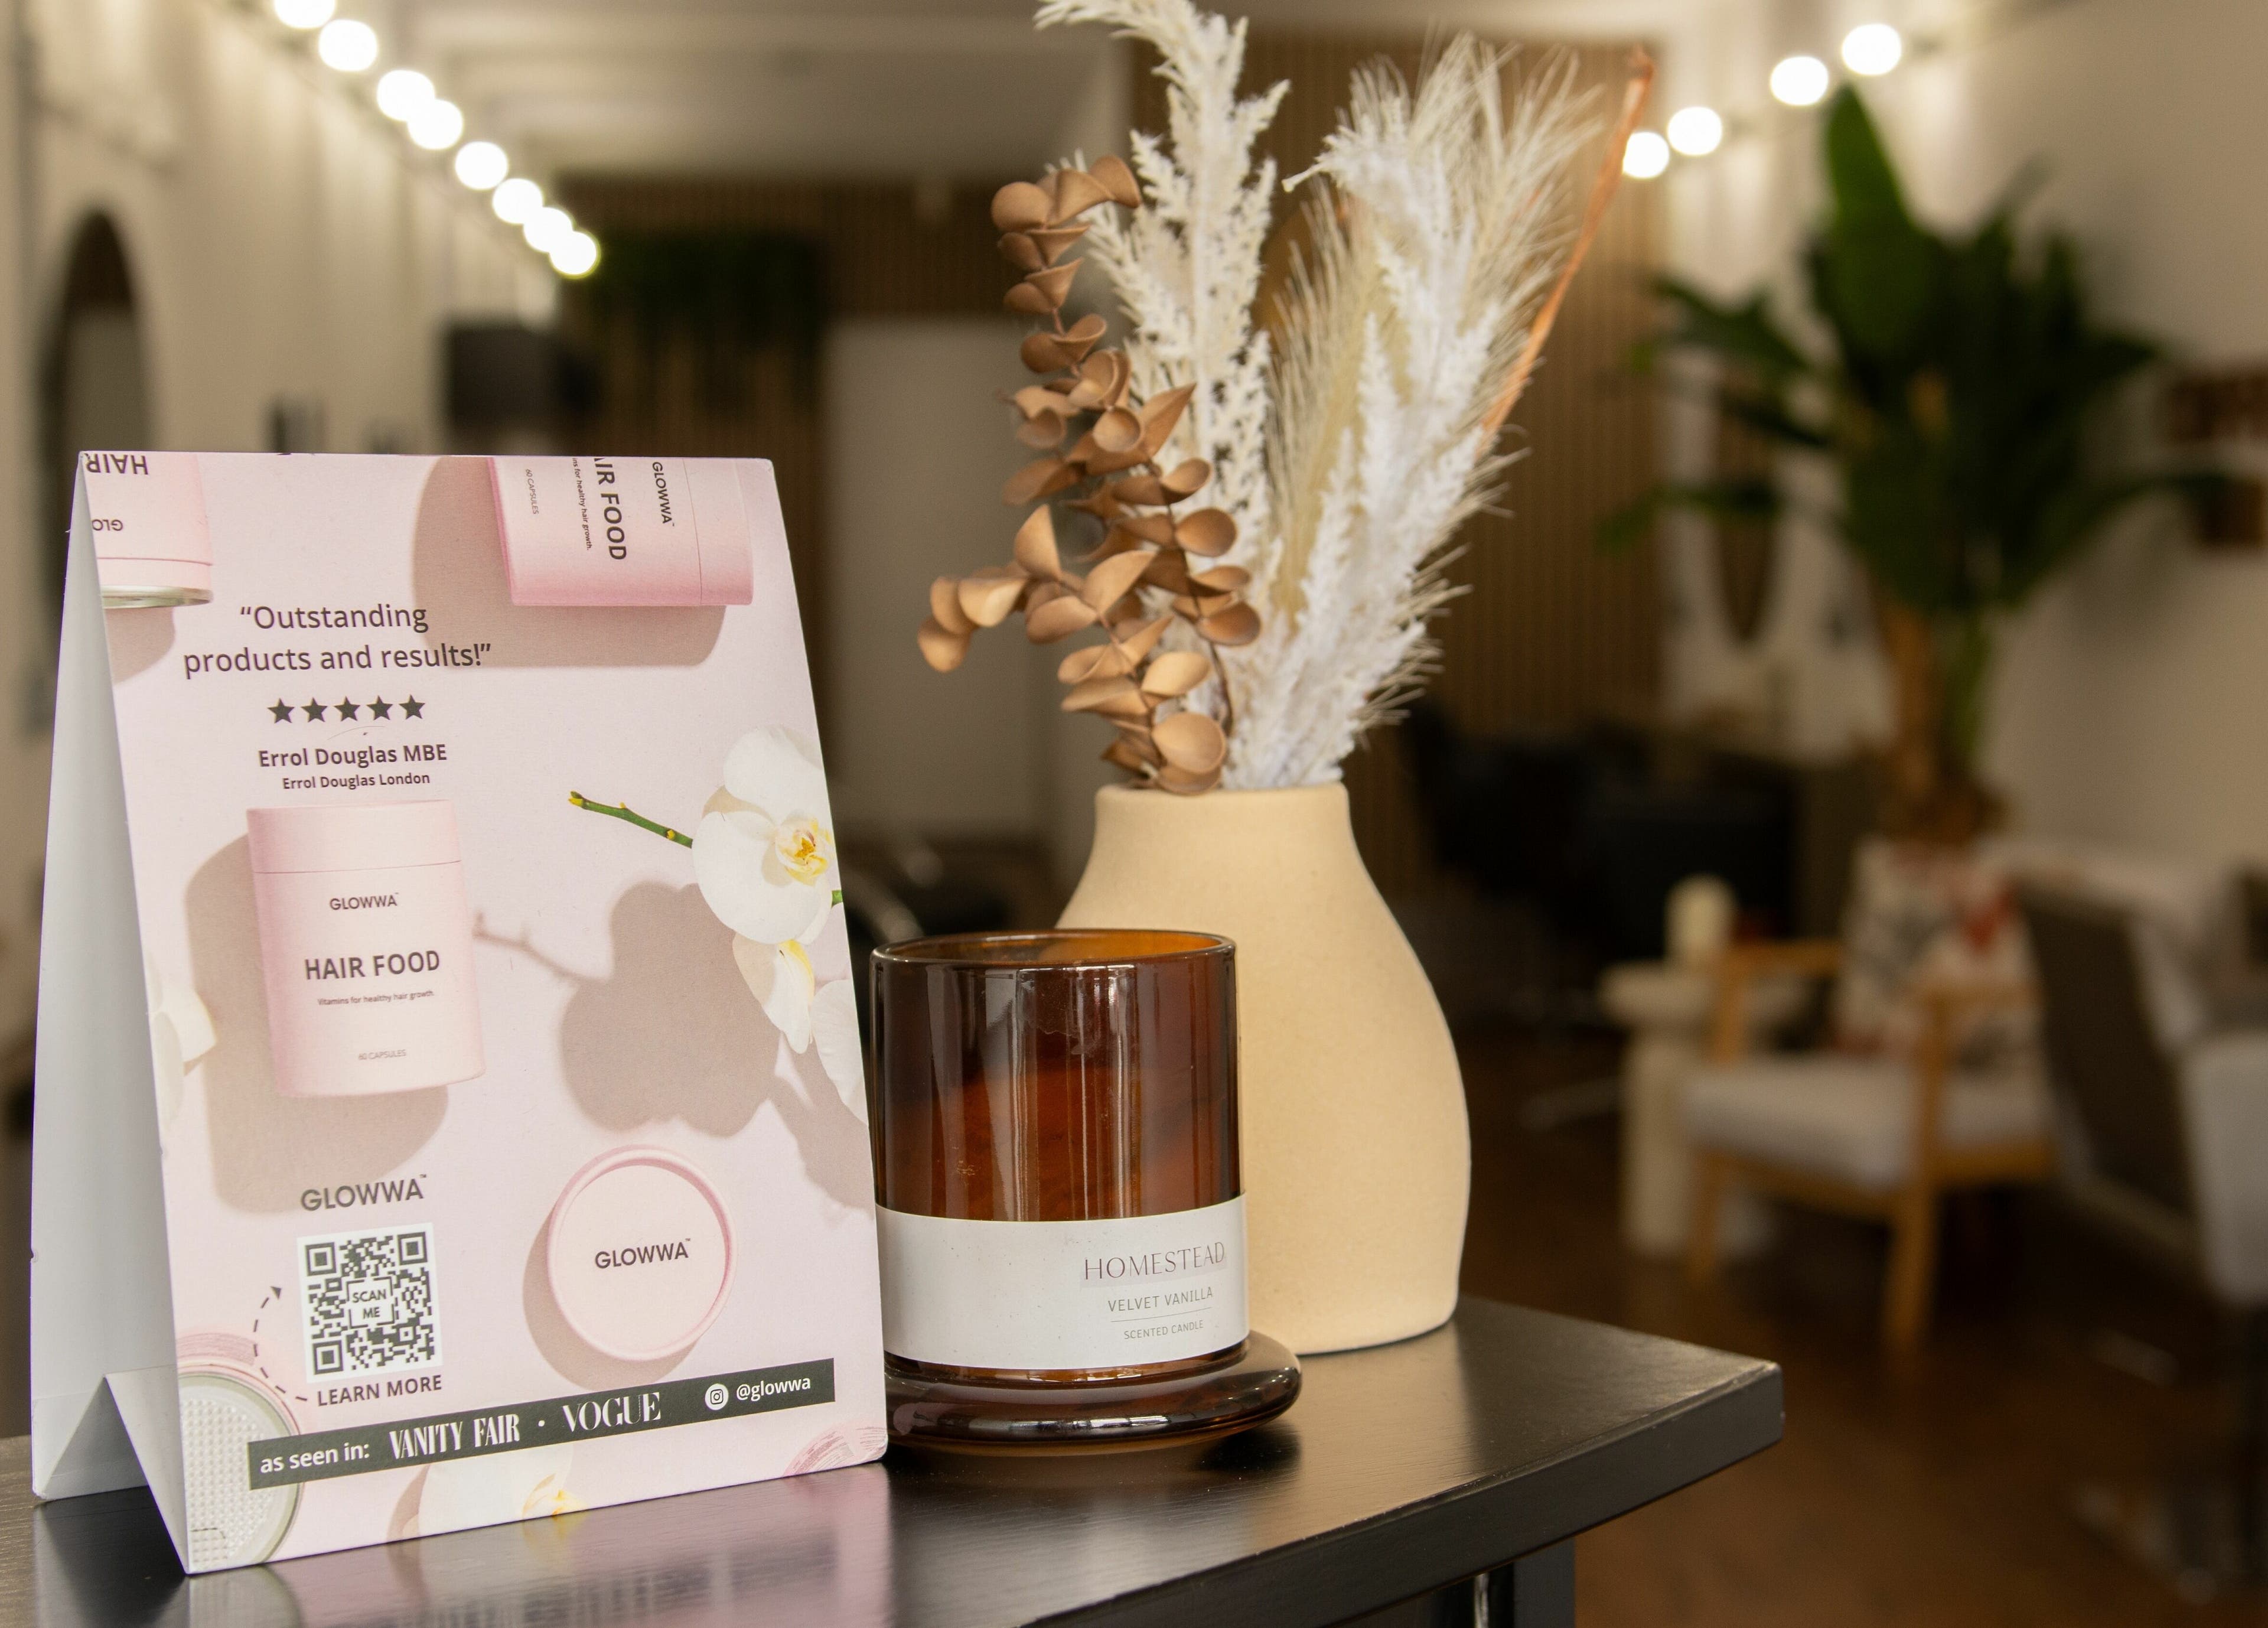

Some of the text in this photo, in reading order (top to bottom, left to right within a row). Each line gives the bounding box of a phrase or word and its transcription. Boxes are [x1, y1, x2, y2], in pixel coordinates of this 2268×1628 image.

[526, 468, 539, 515] 60 CAPSULES
[576, 480, 587, 507] healthy
[601, 493, 627, 560] FOOD
[240, 603, 429, 633] “Outstanding
[184, 647, 311, 679] products
[320, 645, 372, 670] and
[259, 744, 447, 768] Errol Douglas MBE
[282, 772, 431, 790] Errol Douglas London
[305, 950, 440, 980] HAIR FOOD
[1084, 1242, 1225, 1280] HOMESTEAD
[353, 1288, 386, 1303] SCAN
[1107, 1286, 1213, 1312] VELVET VANILLA
[363, 1306, 380, 1319] ME
[1123, 1320, 1204, 1340] SCENTED CANDLE
[317, 1374, 442, 1406] LEARN MORE
[736, 1375, 812, 1402] @glowwa
[260, 1392, 662, 1474] as seen in: VANITY FAIR VOGUE
